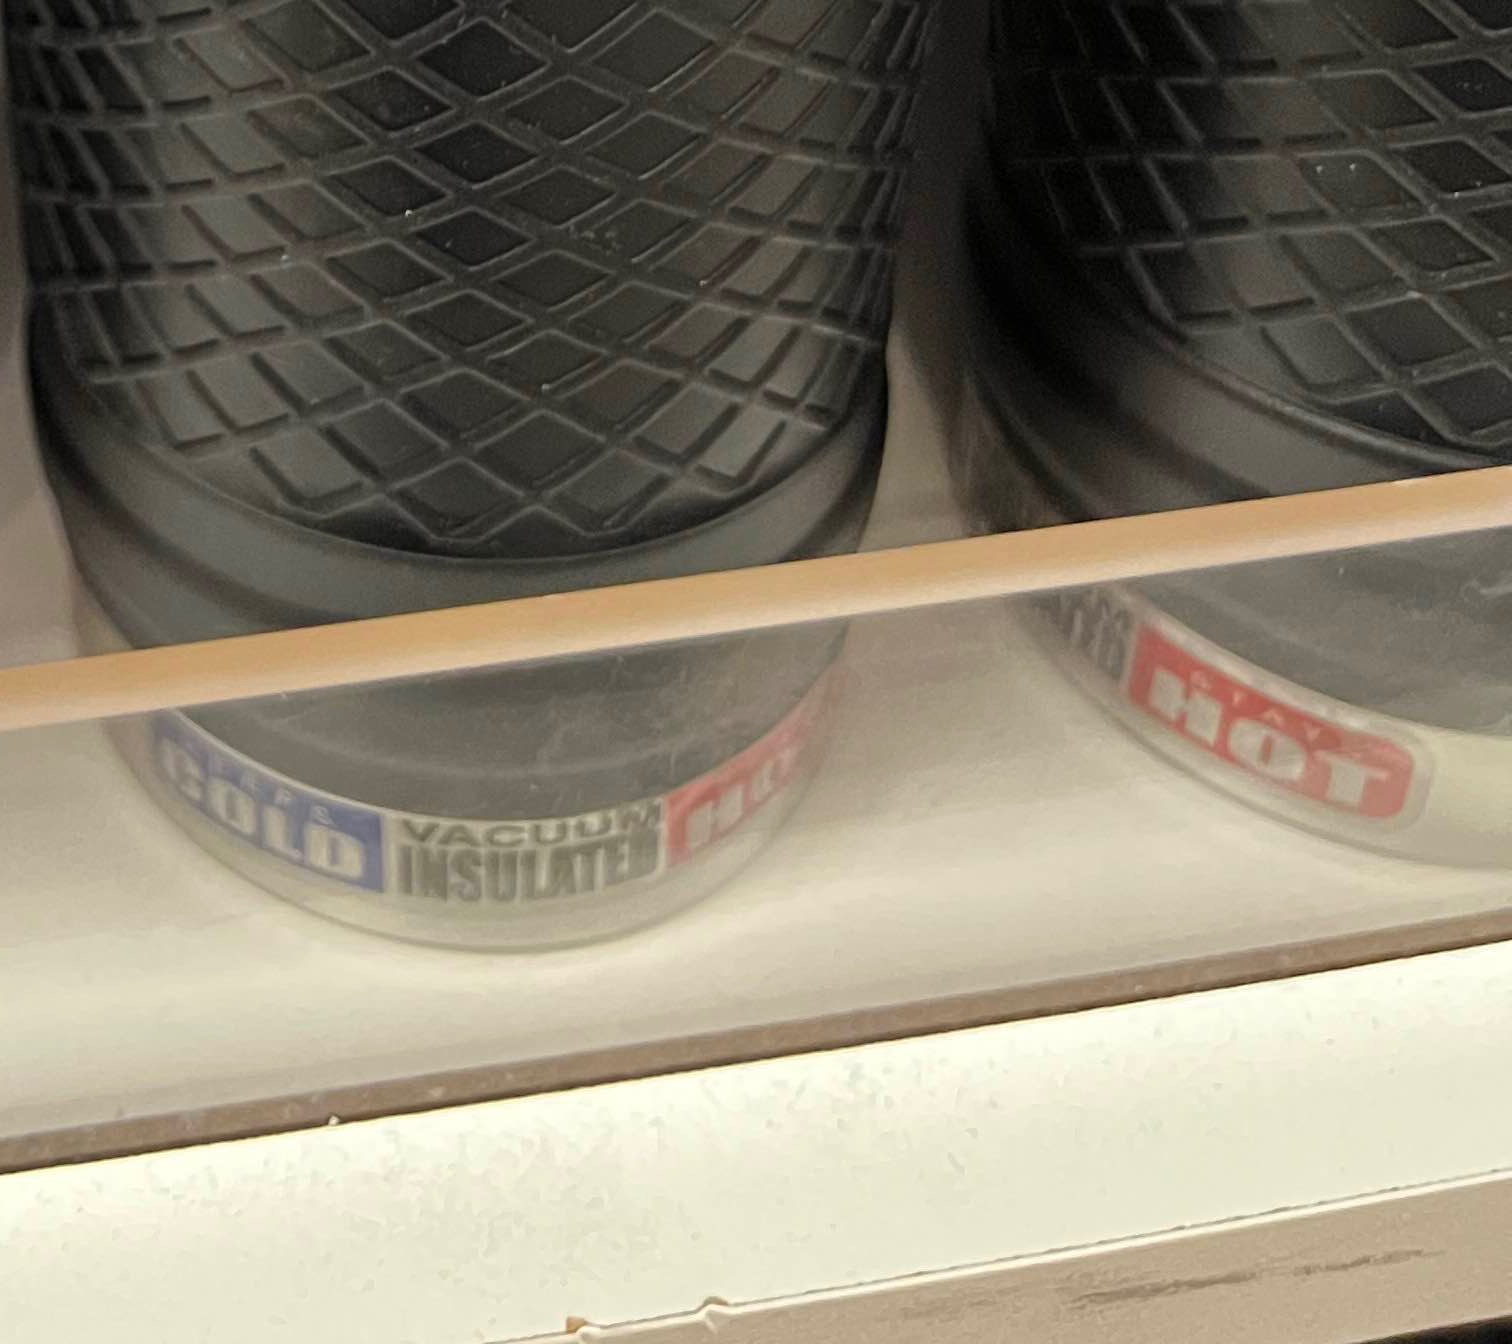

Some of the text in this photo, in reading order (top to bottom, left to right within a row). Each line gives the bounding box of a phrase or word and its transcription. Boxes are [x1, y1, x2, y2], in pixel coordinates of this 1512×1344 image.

[1149, 669, 1389, 808] HOT
[156, 736, 364, 880] COLD
[402, 799, 663, 848] VACUUM
[394, 827, 661, 902] INSULATED
